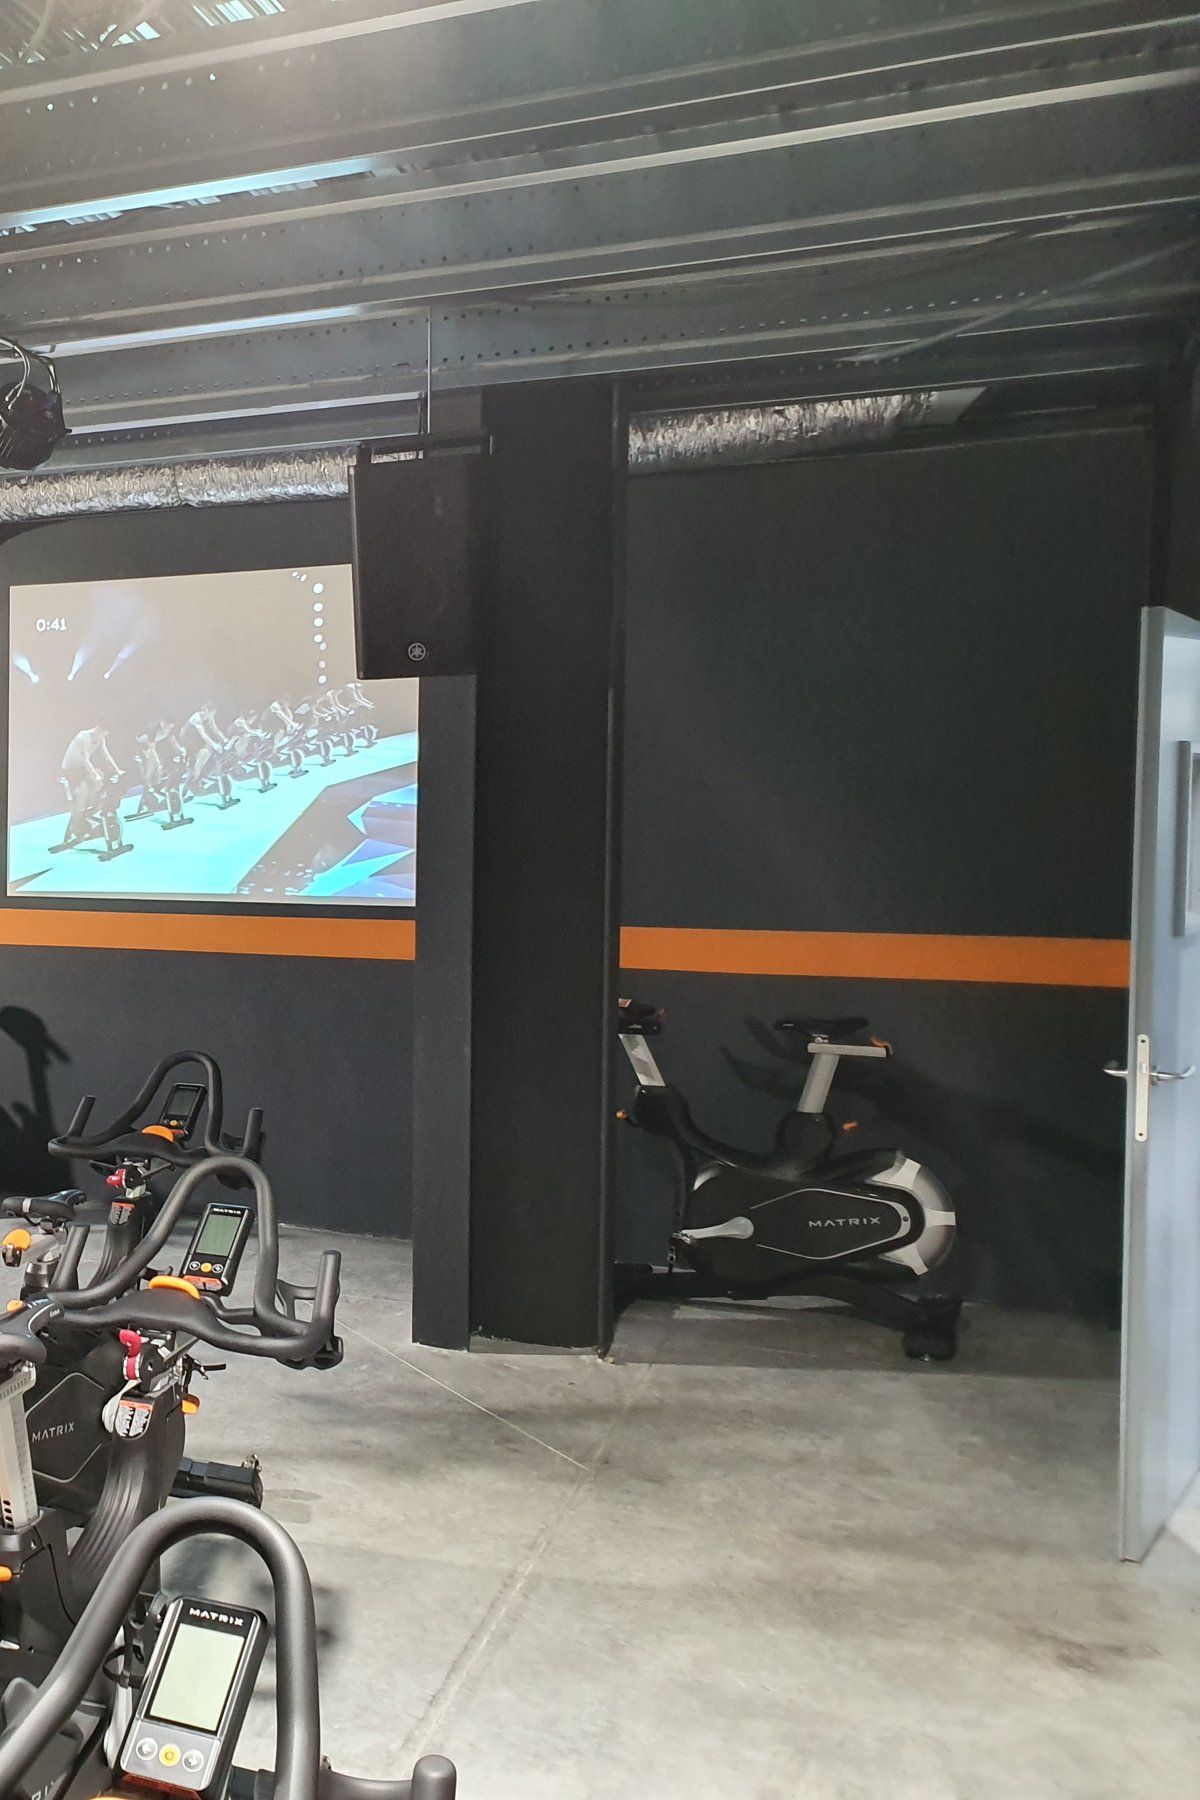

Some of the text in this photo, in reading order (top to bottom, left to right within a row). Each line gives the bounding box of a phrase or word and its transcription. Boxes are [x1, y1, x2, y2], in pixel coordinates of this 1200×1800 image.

[36, 617, 67, 632] 0:41
[808, 1216, 881, 1228] MATRIX
[31, 1421, 75, 1443] MATRIX
[189, 1607, 244, 1627] MATRIX
